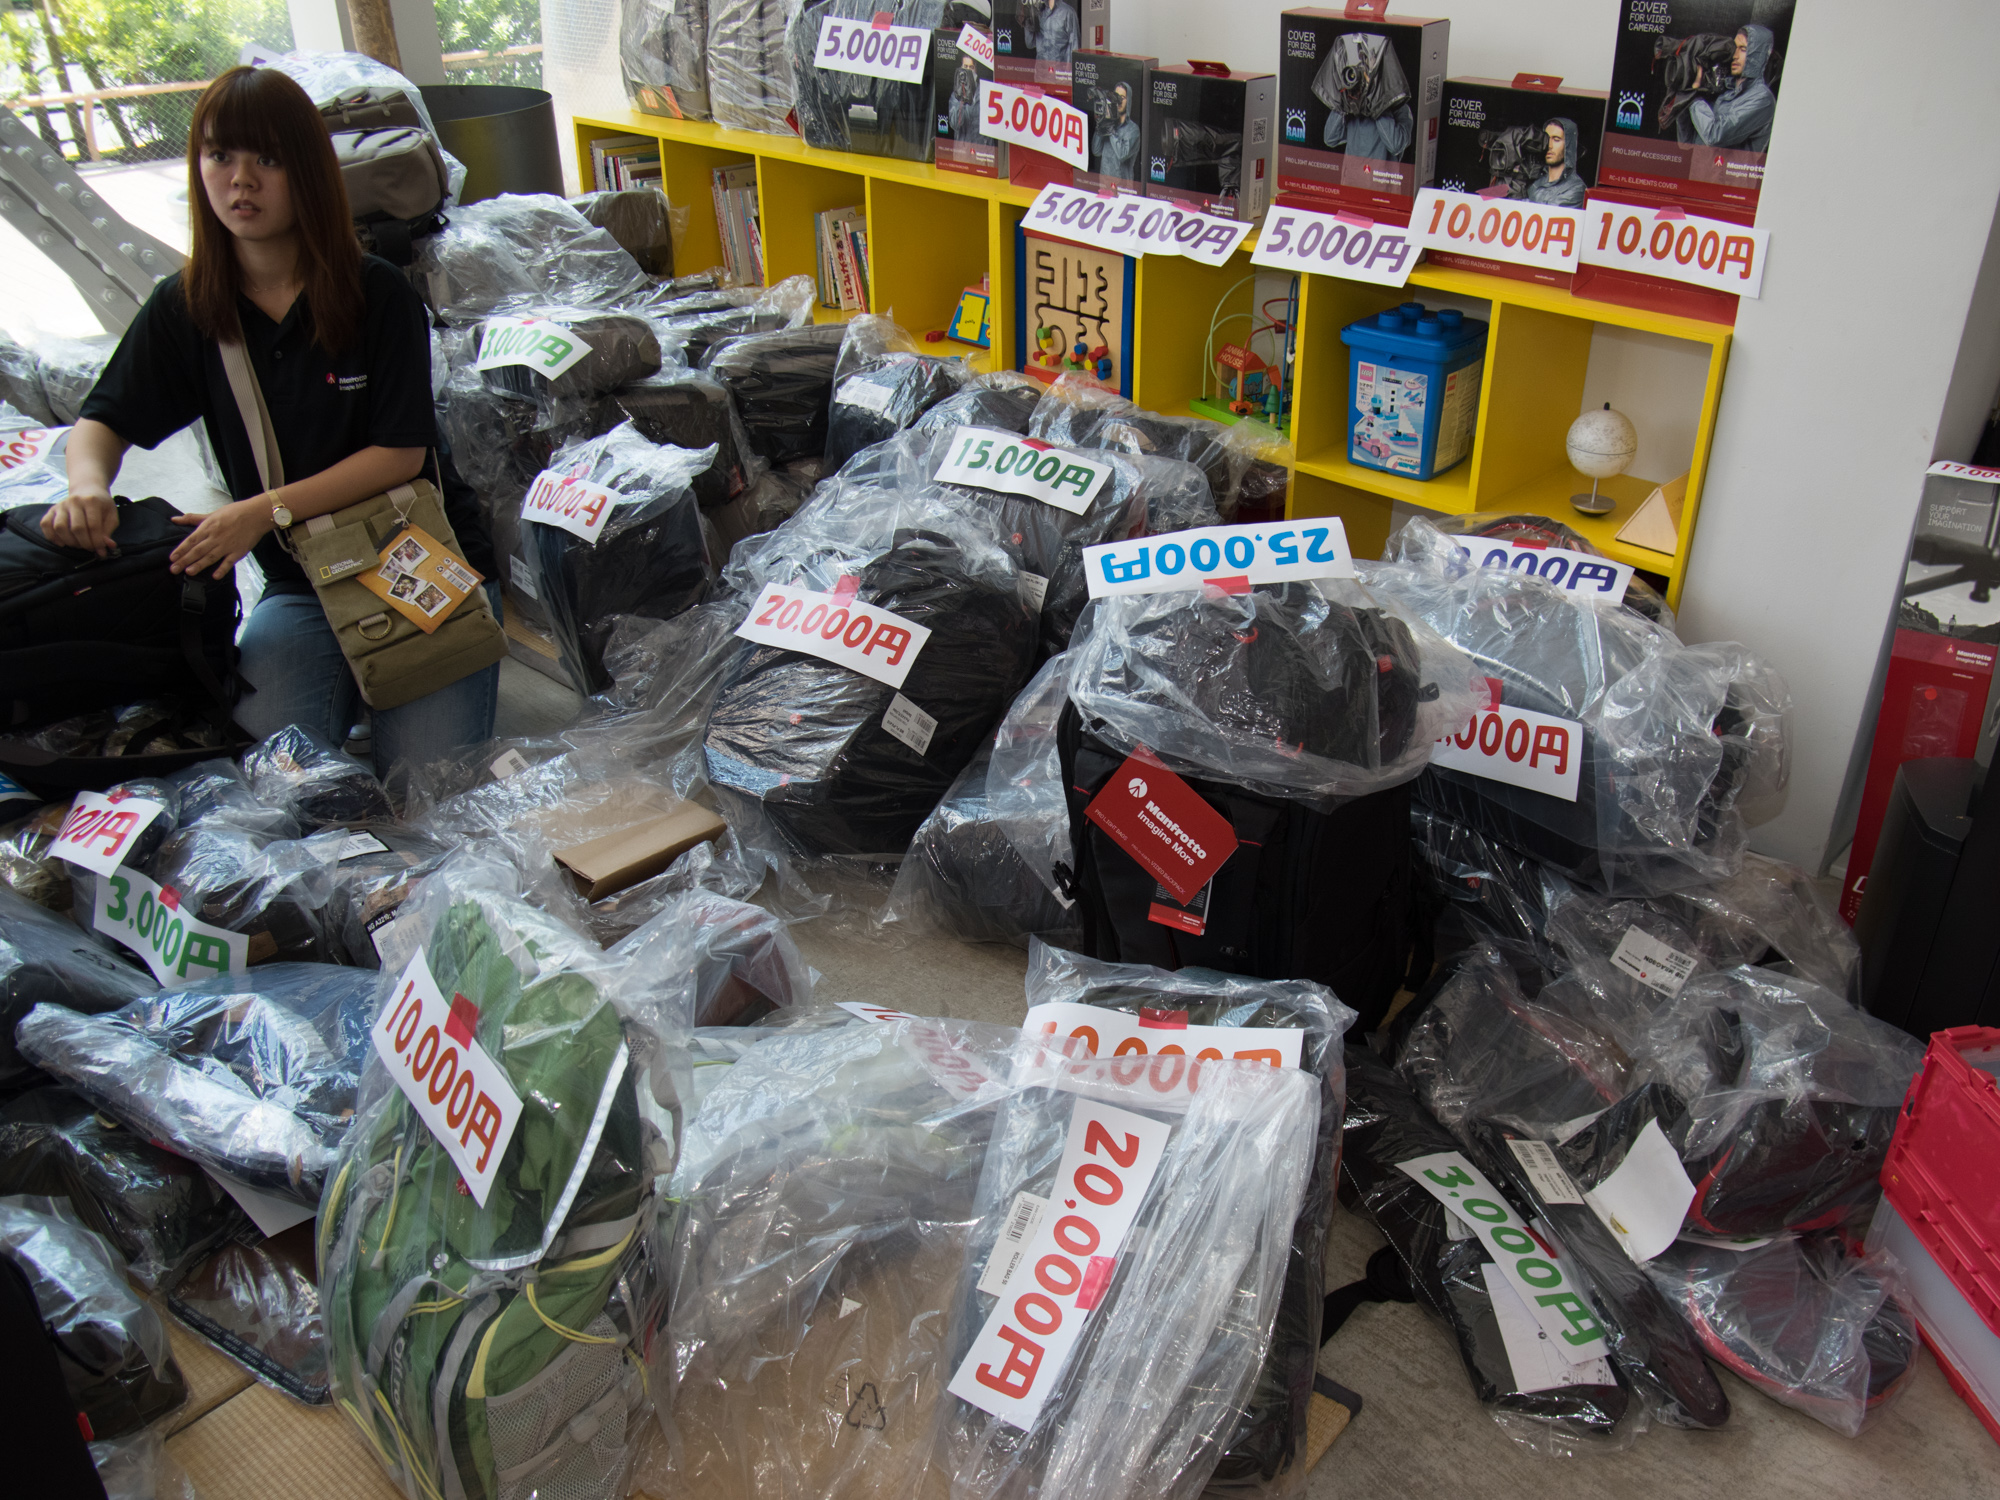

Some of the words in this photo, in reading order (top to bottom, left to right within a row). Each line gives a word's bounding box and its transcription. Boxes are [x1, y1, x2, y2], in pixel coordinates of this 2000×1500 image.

[1631, 0, 1668, 14] COVER
[1629, 13, 1645, 22] FOR
[1646, 14, 1671, 24] VIDEO
[1628, 23, 1665, 33] CAMERAS
[937, 38, 957, 48] COVER
[1288, 30, 1315, 42] COVER
[824, 25, 922, 70] 5,000円
[964, 33, 994, 63] 2,000
[1288, 41, 1299, 49] FOR
[1300, 42, 1316, 51] DSLR
[1287, 49, 1315, 59] CAMERAS
[1075, 62, 1096, 72] COVER
[1075, 77, 1096, 86] CAMERAS
[1085, 72, 1099, 80] VIDEO
[1153, 81, 1177, 92] COVER
[1153, 90, 1164, 98] FOR
[1165, 91, 1178, 99] DSLR
[1153, 97, 1173, 106] LENSES
[1450, 98, 1482, 112] COVER
[987, 90, 1083, 154] 5,000円
[1449, 109, 1463, 118] FOR
[1464, 110, 1486, 121] VIDEO
[1616, 111, 1641, 126] RAIN
[1448, 118, 1480, 129] CAMERAS
[1286, 126, 1305, 138] RAIN
[1641, 151, 1682, 163] ACCESSORIES
[1308, 160, 1339, 171] ACCESSORIES
[1727, 162, 1766, 173] Manfrotto
[1373, 170, 1404, 180] Manfrotto
[1726, 169, 1747, 179] Imagine
[1628, 176, 1657, 188] ELEMENTS
[1658, 182, 1678, 190] COVER
[1110, 203, 1239, 255] 5,000円
[1427, 199, 1576, 257] 10,000円
[1266, 216, 1412, 273] 5,000円
[1597, 212, 1755, 280] 10,000円
[481, 326, 574, 368] 3,000円
[1225, 345, 1248, 359] ANIMA
[1219, 352, 1244, 368] HOUSE
[1361, 368, 1373, 377] LEGO
[954, 437, 1096, 497] 15,000円
[528, 477, 608, 528] 10,000円
[1930, 503, 1967, 516] SUPPORT
[1929, 511, 1950, 520] YOUR
[1927, 518, 1983, 533] IMAGINATION
[1100, 527, 1335, 584] 25,000円
[330, 558, 354, 570] NATIONAL
[755, 594, 912, 666] 20,000円
[1955, 656, 1975, 665] Imagine
[1975, 659, 1989, 667] More
[1957, 649, 1992, 662] Manfrotto
[1435, 713, 1569, 776] ,000円
[1095, 809, 1105, 820] PRO
[1104, 818, 1117, 831] LIGHT
[1115, 828, 1128, 841] BAGS
[1145, 800, 1207, 860] Manfrotto
[1137, 810, 1172, 845] Imagine
[1171, 842, 1195, 866] More
[1151, 860, 1165, 875] VIDEO
[1163, 873, 1186, 895] BACKPACK
[106, 875, 231, 984] 3,000円
[384, 979, 502, 1175] 10,000円
[975, 1119, 1140, 1400] 20,000円
[1008, 1251, 1019, 1269] ROLLER
[1422, 1166, 1606, 1346] 3,000円
[1004, 1269, 1012, 1279] BAG
